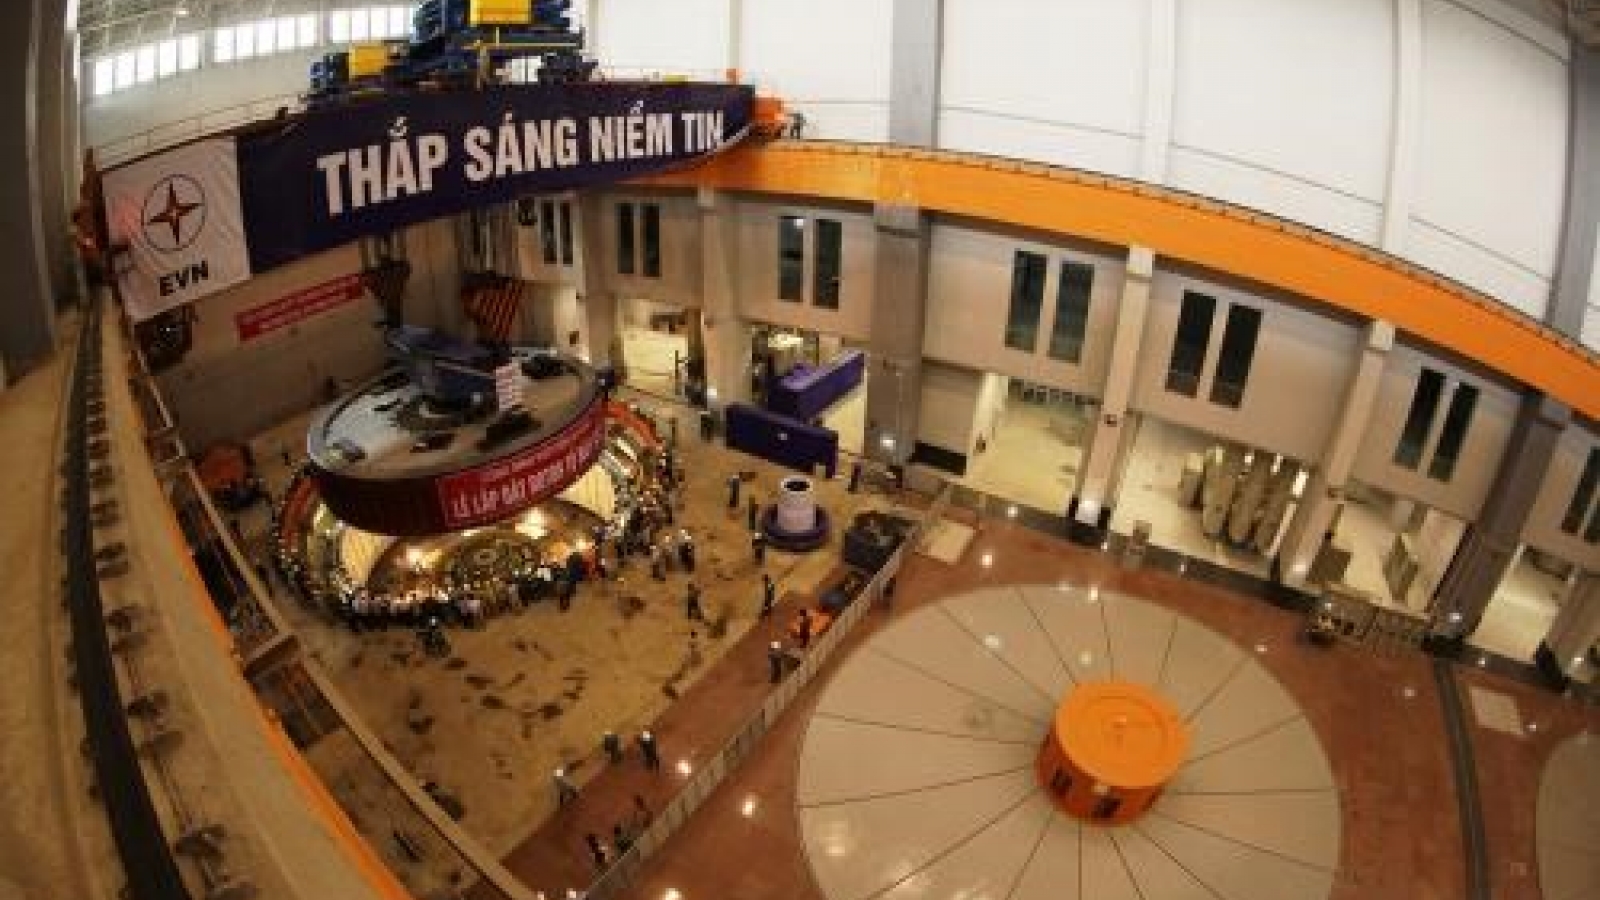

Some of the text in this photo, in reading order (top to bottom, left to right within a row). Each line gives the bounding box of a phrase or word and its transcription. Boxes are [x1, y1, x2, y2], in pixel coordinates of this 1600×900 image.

[316, 116, 449, 215] THẮP
[463, 112, 580, 181] SÁNG
[681, 110, 725, 153] TIN
[158, 260, 209, 297] EVN
